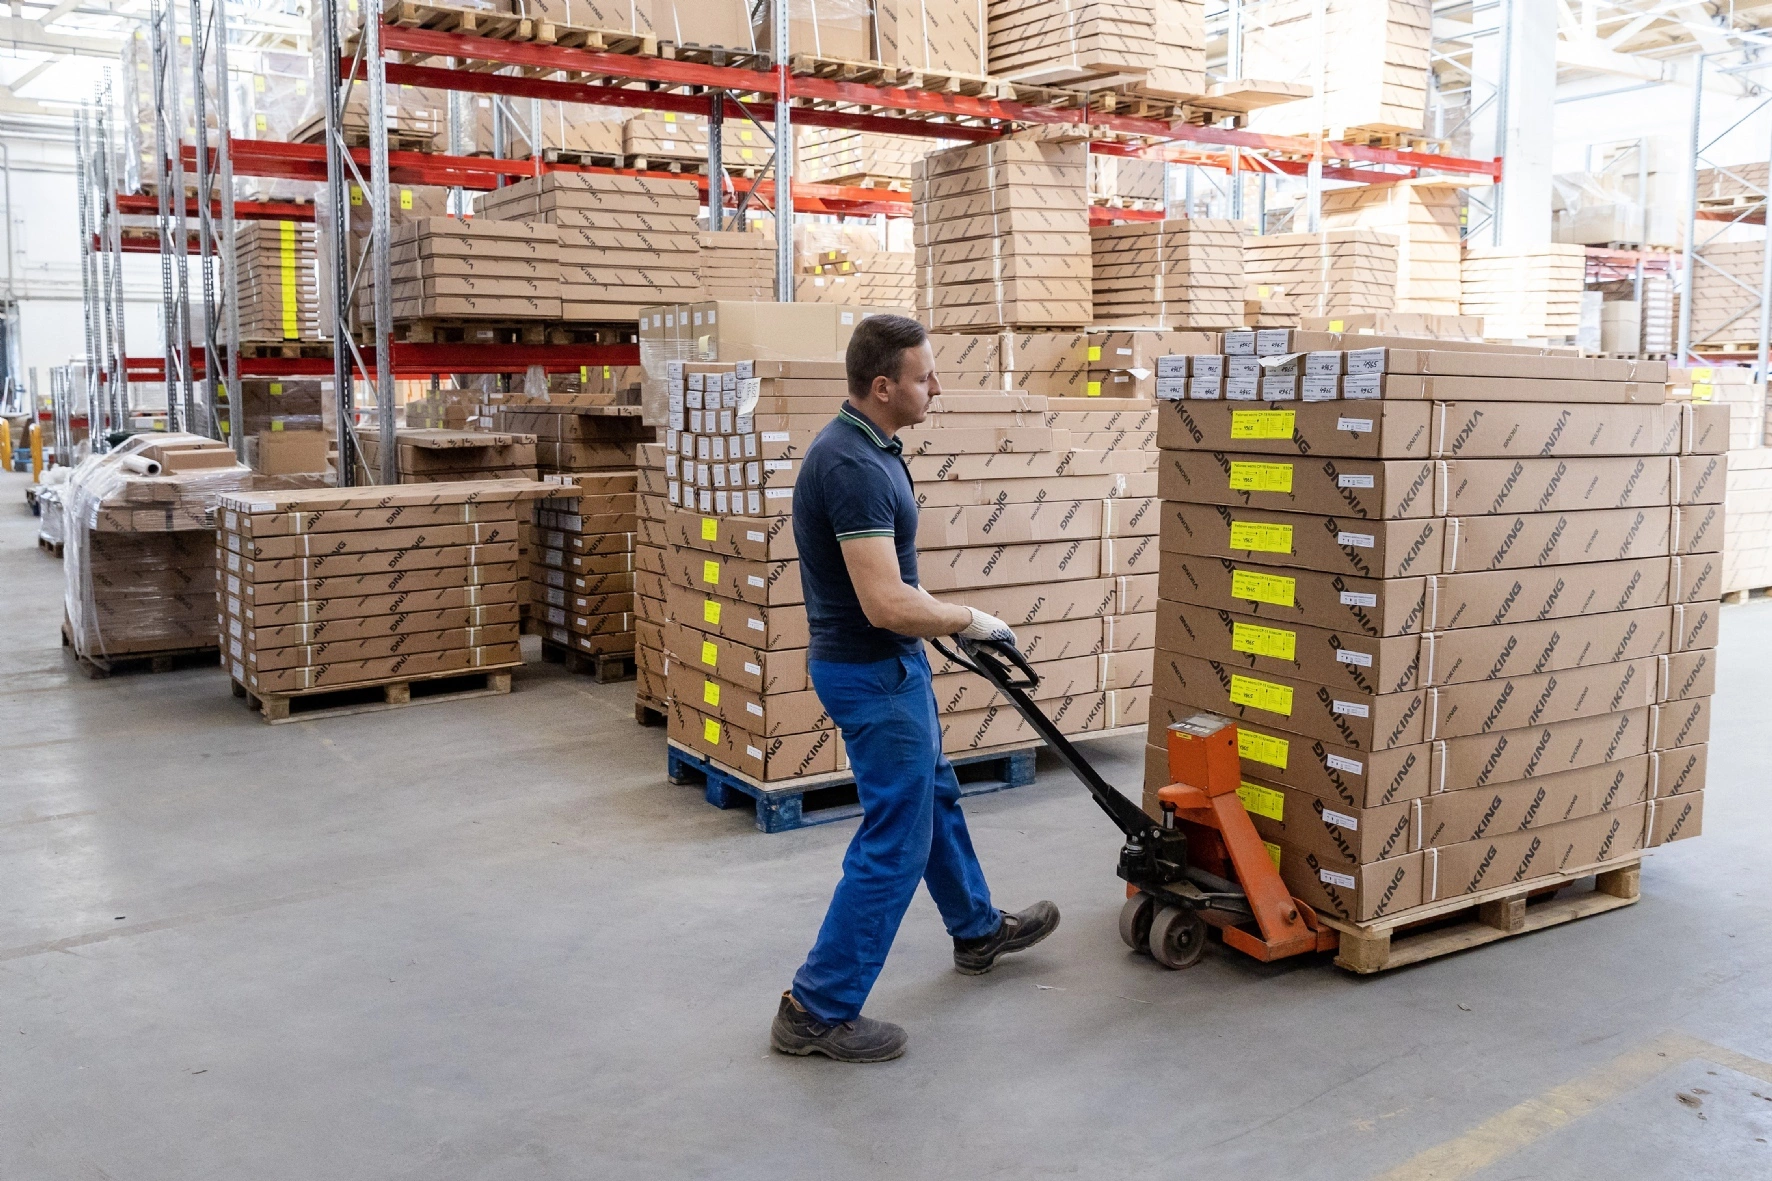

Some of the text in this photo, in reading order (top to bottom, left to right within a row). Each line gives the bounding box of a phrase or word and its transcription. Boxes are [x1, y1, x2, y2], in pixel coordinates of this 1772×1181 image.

[957, 337, 979, 365] VIKING
[1406, 425, 1425, 451] VIKING
[1503, 424, 1519, 449] VIKING
[1590, 423, 1604, 447] VIKING
[1630, 425, 1643, 448] VIKING
[1174, 461, 1191, 485] VIKING
[1585, 476, 1598, 499] VIKING
[1177, 512, 1193, 538] VIKING
[1585, 529, 1598, 553] VIKING
[1182, 564, 1198, 590] VIKING
[1580, 589, 1596, 614] VIKING
[1180, 615, 1195, 641] VIKING
[1448, 602, 1467, 628] VIKING
[1576, 641, 1591, 666] VIKING
[1170, 661, 1187, 688] VIKING
[1443, 658, 1463, 685] VIKING
[1574, 687, 1589, 712] VIKING
[969, 706, 998, 749] VIKING
[794, 731, 830, 777] VIKING
[1569, 738, 1584, 763] VIKING
[1669, 754, 1697, 796] IKING
[1469, 795, 1502, 840] IKING
[1518, 787, 1546, 830] IKING
[1563, 795, 1578, 819] VIKING
[1375, 815, 1408, 862] IKING
[1558, 844, 1574, 869] VIKING
